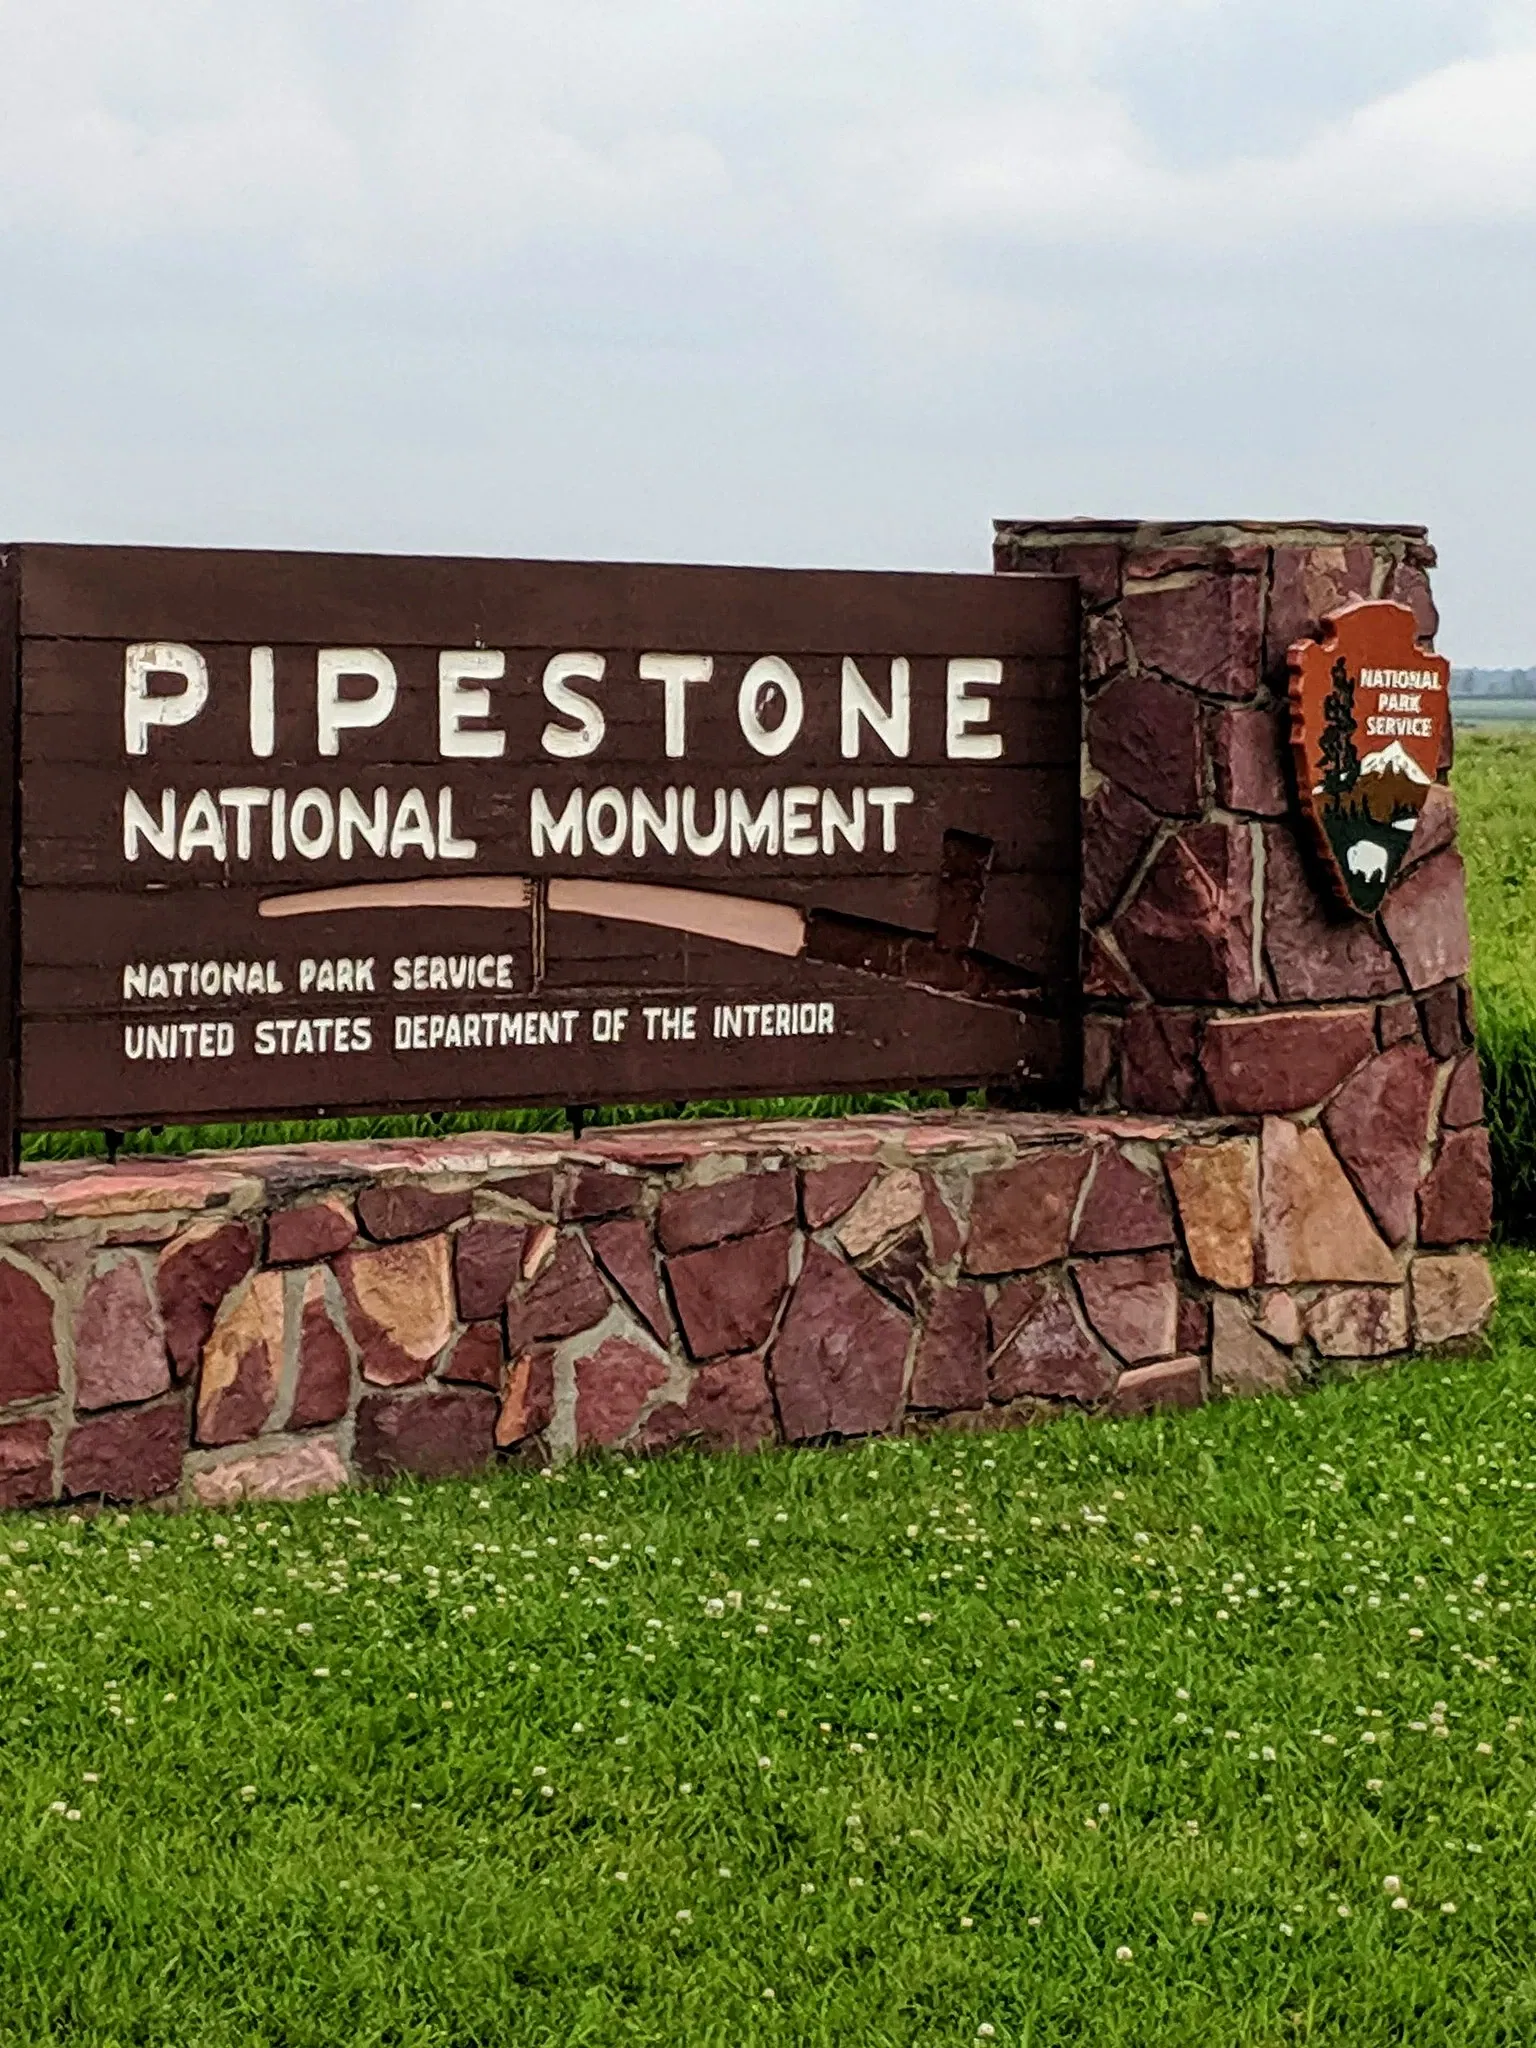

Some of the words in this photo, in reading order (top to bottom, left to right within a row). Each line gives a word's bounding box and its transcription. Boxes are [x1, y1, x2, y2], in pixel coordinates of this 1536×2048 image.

[124, 642, 1002, 758] PIPESTONE
[1361, 669, 1441, 689] NATIONAL
[1367, 716, 1432, 736] SERVICE
[1379, 694, 1421, 713] PARK
[123, 786, 477, 860] NATIONAL
[530, 786, 914, 857] MONUMENT
[123, 960, 283, 999] NATIONAL
[300, 958, 375, 992] PARK
[393, 954, 514, 990] SERVICE
[125, 1022, 235, 1059] UNITED
[254, 1017, 372, 1055] STATES
[395, 1010, 578, 1049] DEPARTMENT
[592, 1007, 626, 1041] OF
[642, 1006, 696, 1040] THE
[713, 1002, 834, 1038] INTERIOR
